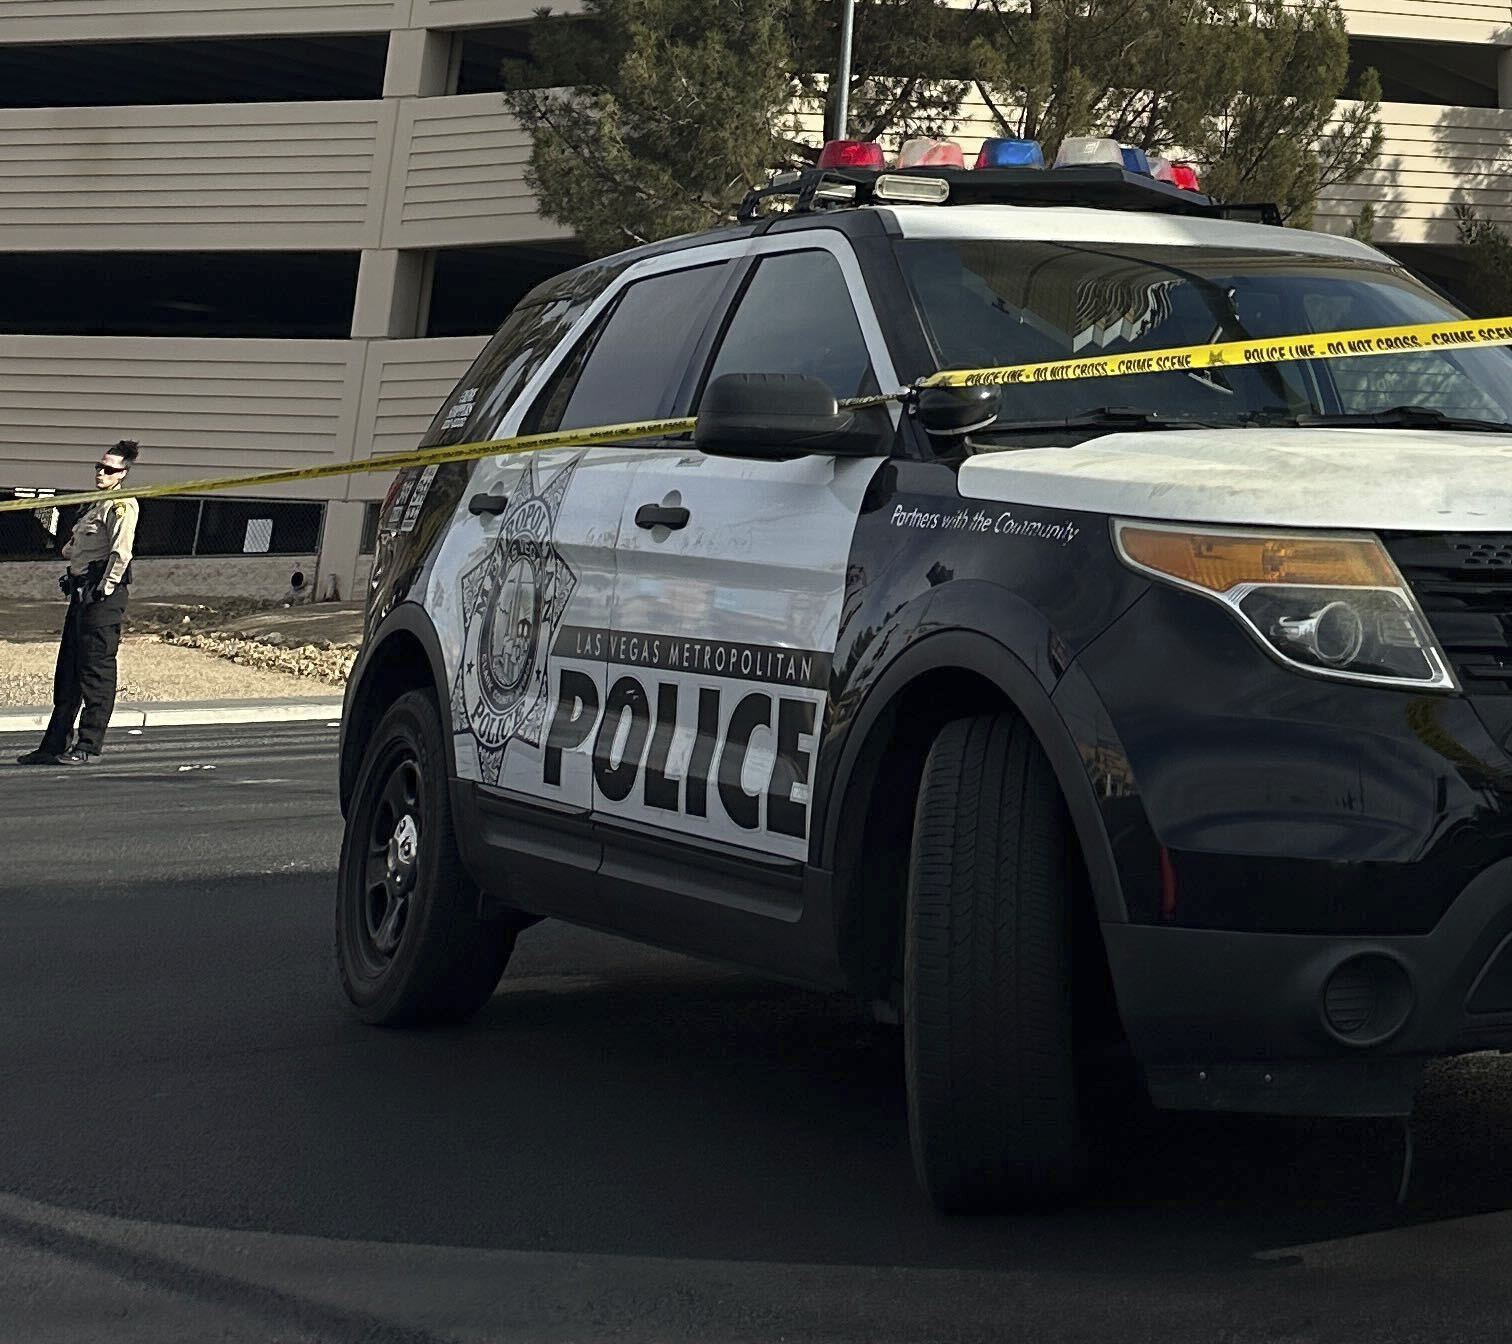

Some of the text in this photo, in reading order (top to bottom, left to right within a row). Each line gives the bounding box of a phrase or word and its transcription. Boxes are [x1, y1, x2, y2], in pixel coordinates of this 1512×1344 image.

[1073, 361, 1108, 377] CROSS
[1118, 357, 1154, 374] CRIME
[1156, 354, 1192, 369] SCENE
[1244, 346, 1286, 362] POLICE
[1347, 339, 1375, 353] NOT
[1376, 334, 1420, 351] CROSS
[1431, 330, 1477, 346] CRIME
[890, 504, 1080, 547] Partners with the Community
[576, 632, 813, 682] LAS VEGAS METROPOLITAN
[471, 695, 527, 746] POLICE
[543, 668, 818, 841] POLICE
